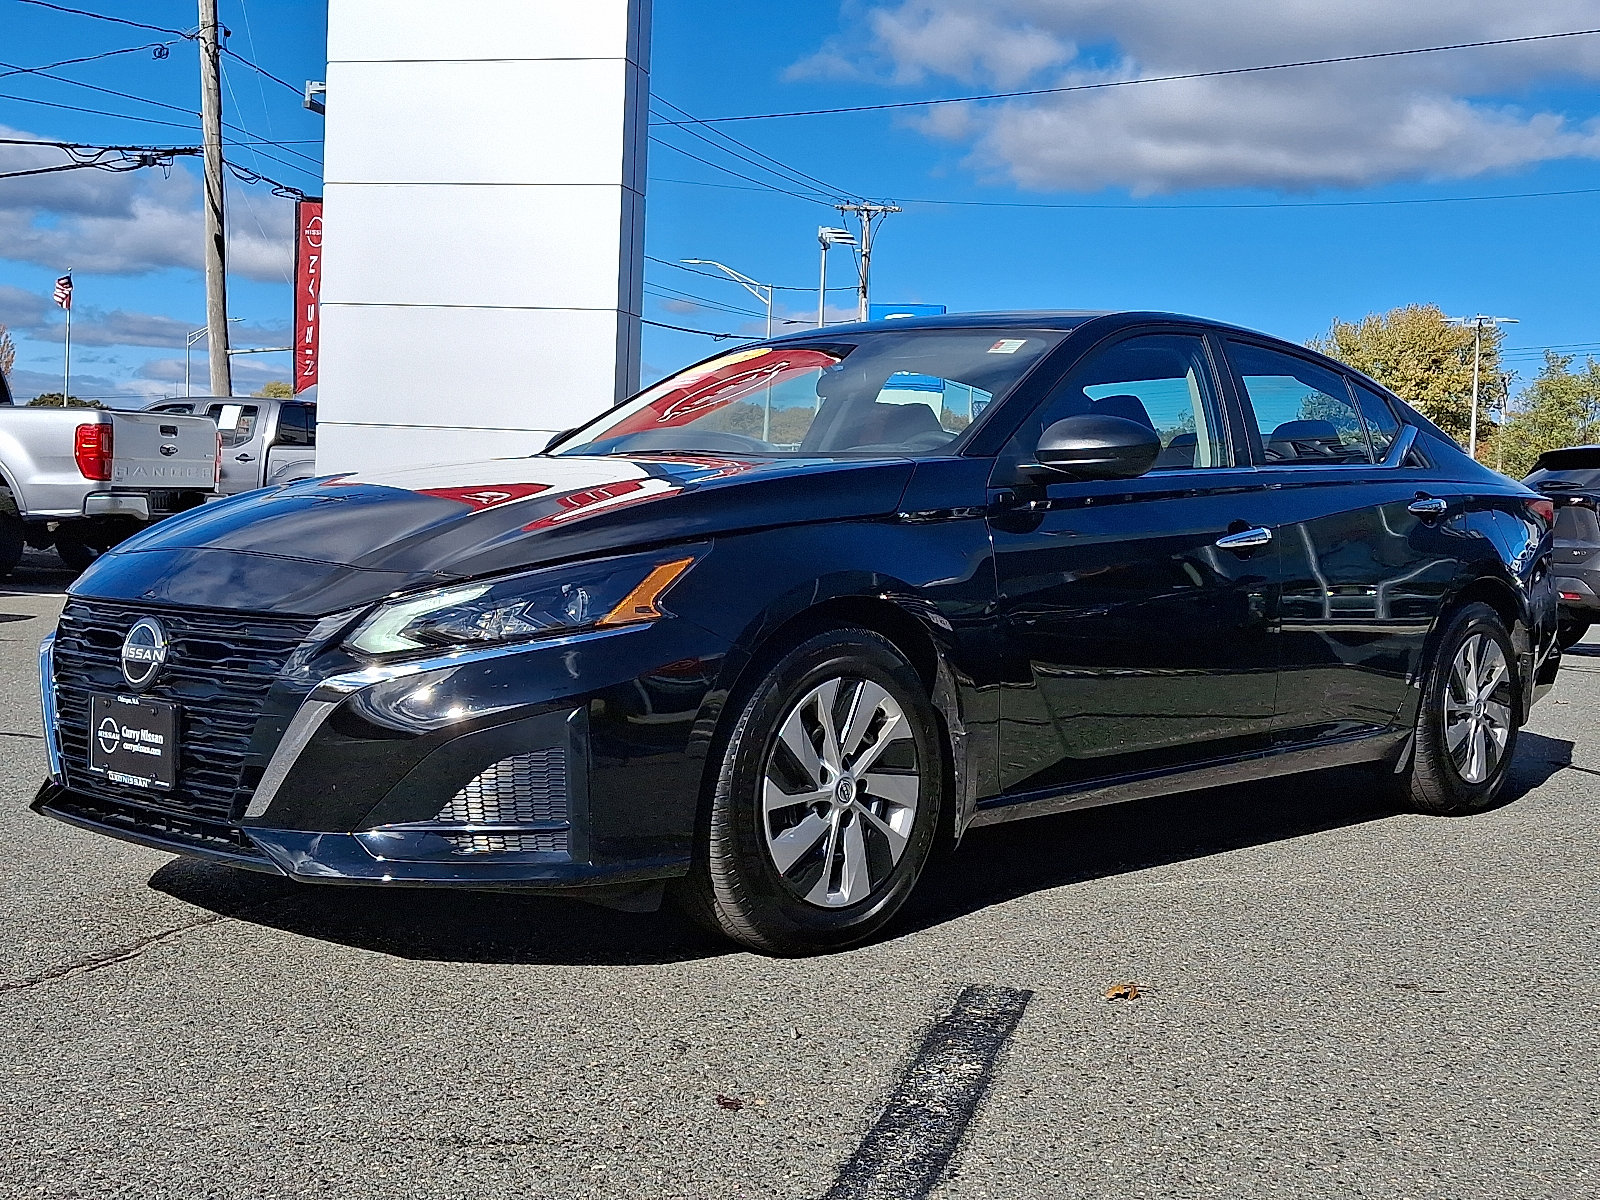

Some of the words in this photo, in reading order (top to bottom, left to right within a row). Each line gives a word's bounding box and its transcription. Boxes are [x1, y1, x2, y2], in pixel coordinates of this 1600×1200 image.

[304, 255, 319, 376] NISSAN
[98, 729, 120, 741] NISSAN
[121, 725, 140, 742] Curry
[140, 729, 163, 745] Nissan
